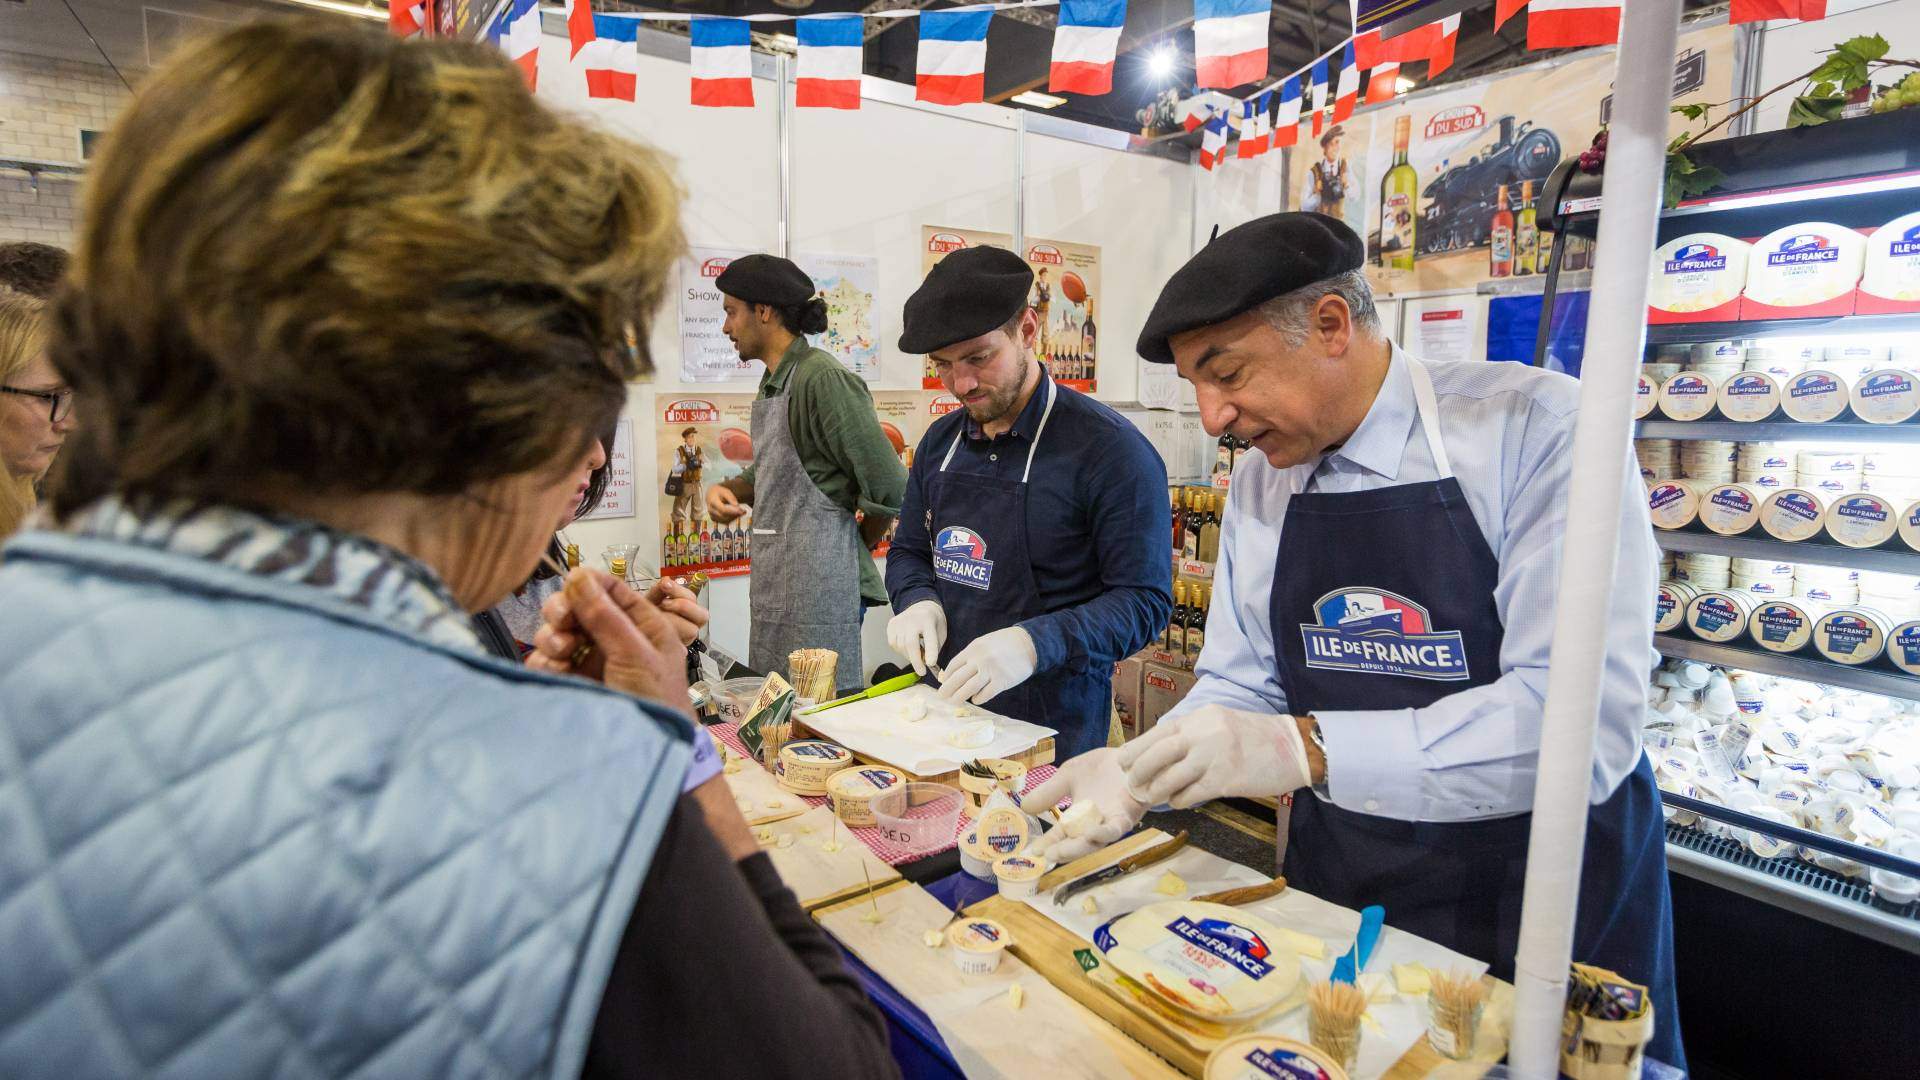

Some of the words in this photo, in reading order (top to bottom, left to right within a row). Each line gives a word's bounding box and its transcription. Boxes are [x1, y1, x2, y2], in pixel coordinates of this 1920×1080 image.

[1436, 121, 1449, 135] DU
[1454, 117, 1473, 131] SUD
[1894, 243, 1910, 253] ILE
[1771, 254, 1784, 264] ILE
[1795, 250, 1835, 262] FRANCE
[1667, 262, 1680, 271] ILE
[1689, 259, 1723, 270] FRANCE
[1792, 388, 1802, 396] ILE
[1808, 384, 1835, 393] FRANCE
[1863, 388, 1874, 396] ILE
[1880, 384, 1908, 393] FRANCE
[675, 412, 687, 421] DU
[690, 411, 707, 421] SUD
[1663, 490, 1684, 503] FRANCE
[1727, 499, 1750, 510] FRANCE
[1778, 499, 1787, 507] ILE
[1792, 505, 1816, 519] FRANCE
[1858, 510, 1884, 520] FRANCE
[946, 559, 986, 581] FRANCE
[1712, 607, 1735, 619] FRANCE
[1775, 617, 1799, 625] FRANCE
[1843, 627, 1870, 636] FRANCE
[1312, 635, 1343, 658] ILE
[1343, 640, 1362, 655] DE
[1361, 640, 1453, 667] FRANCE
[1360, 662, 1384, 671] DEPUIS
[1175, 921, 1199, 939] ILE
[1208, 937, 1265, 975] FRANCE
